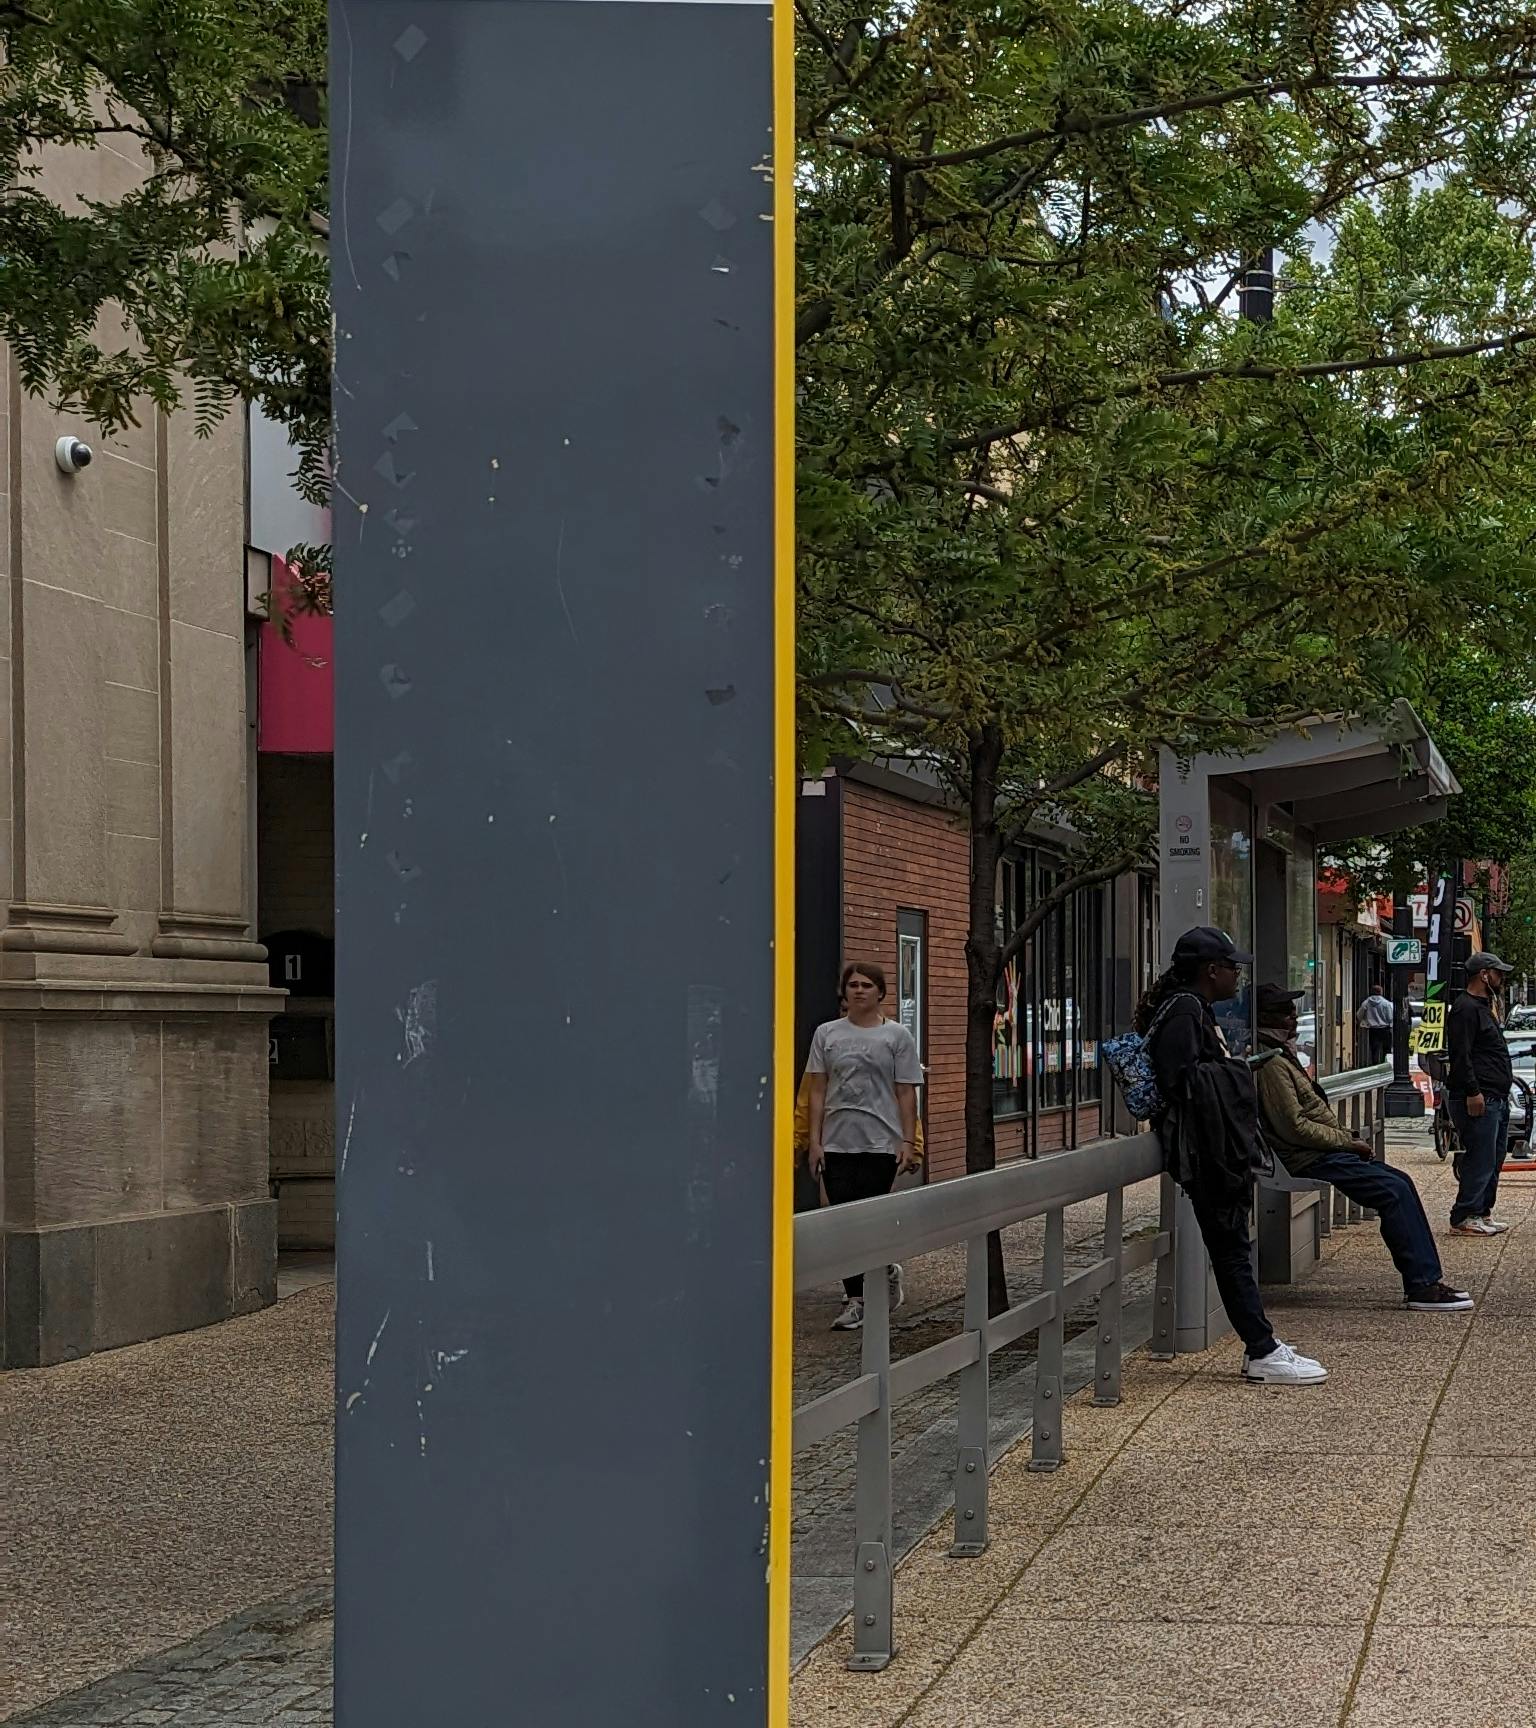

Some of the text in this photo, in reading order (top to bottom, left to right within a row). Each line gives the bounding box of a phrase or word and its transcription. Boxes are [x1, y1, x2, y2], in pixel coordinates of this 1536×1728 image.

[1179, 835, 1190, 844] NO
[1169, 847, 1201, 857] SMOKING
[1410, 941, 1418, 953] 2
[287, 955, 300, 980] 1
